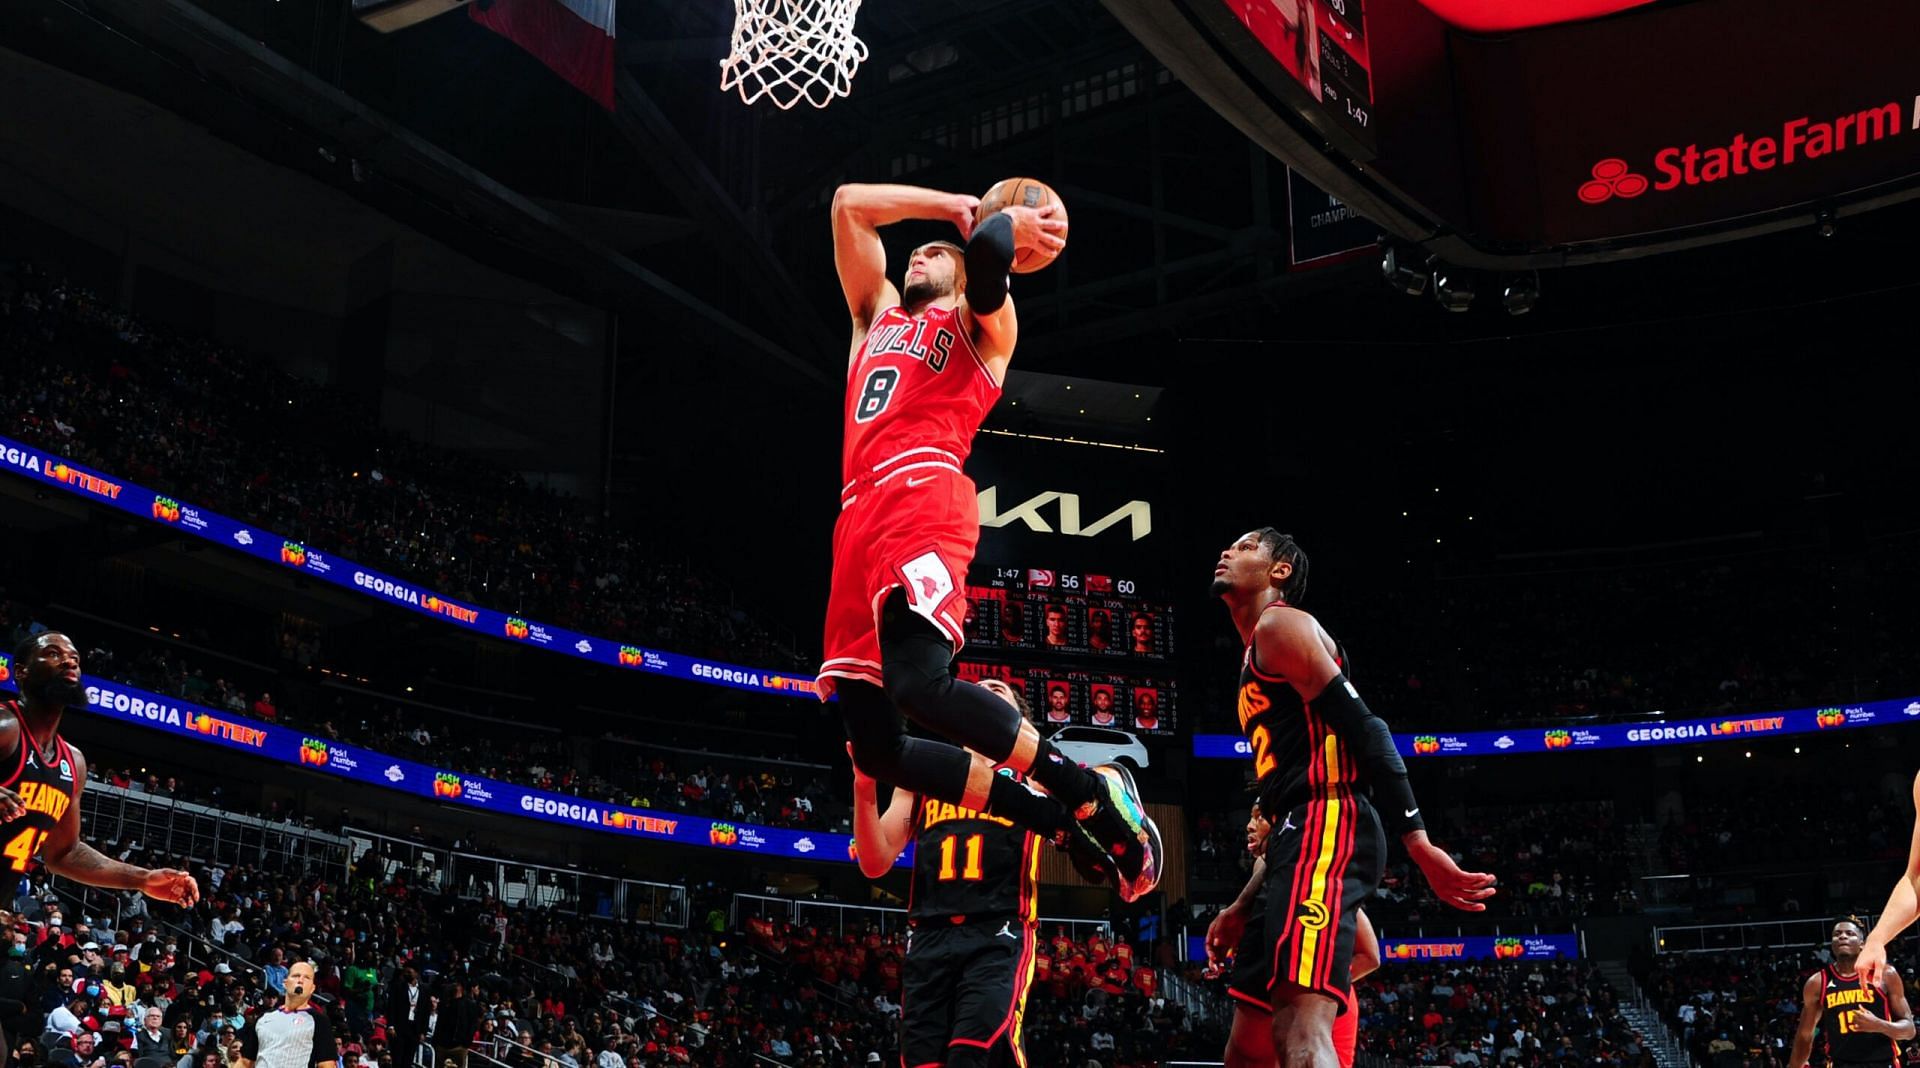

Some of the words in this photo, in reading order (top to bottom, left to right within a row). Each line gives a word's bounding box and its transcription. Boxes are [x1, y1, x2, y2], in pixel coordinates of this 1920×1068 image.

[1346, 98, 1368, 127] 1:47
[855, 366, 900, 424] 8
[44, 460, 122, 500] LOTTERY
[997, 568, 1020, 579] 1:47
[1061, 575, 1079, 589] 56
[1117, 580, 1135, 594] 60
[353, 571, 419, 605] GEORGIA
[420, 593, 479, 624] LOTTERY
[1103, 600, 1124, 609] 100%
[691, 663, 760, 687] GEORGIA
[763, 675, 818, 693] LOTTER
[958, 661, 1012, 679] BULLS
[1109, 675, 1124, 684] 75%
[85, 686, 181, 727] GEORGIA
[184, 711, 268, 748] LOTTERY
[1627, 724, 1708, 742] GEORGIA
[1711, 716, 1784, 735] LOTTERY
[1252, 724, 1277, 779] 2
[520, 795, 599, 824] GEORGIA
[602, 810, 679, 835] LOTTERY
[938, 833, 983, 881] 11
[1385, 943, 1464, 959] LOTTERY
[1826, 989, 1875, 1009] HAWKS
